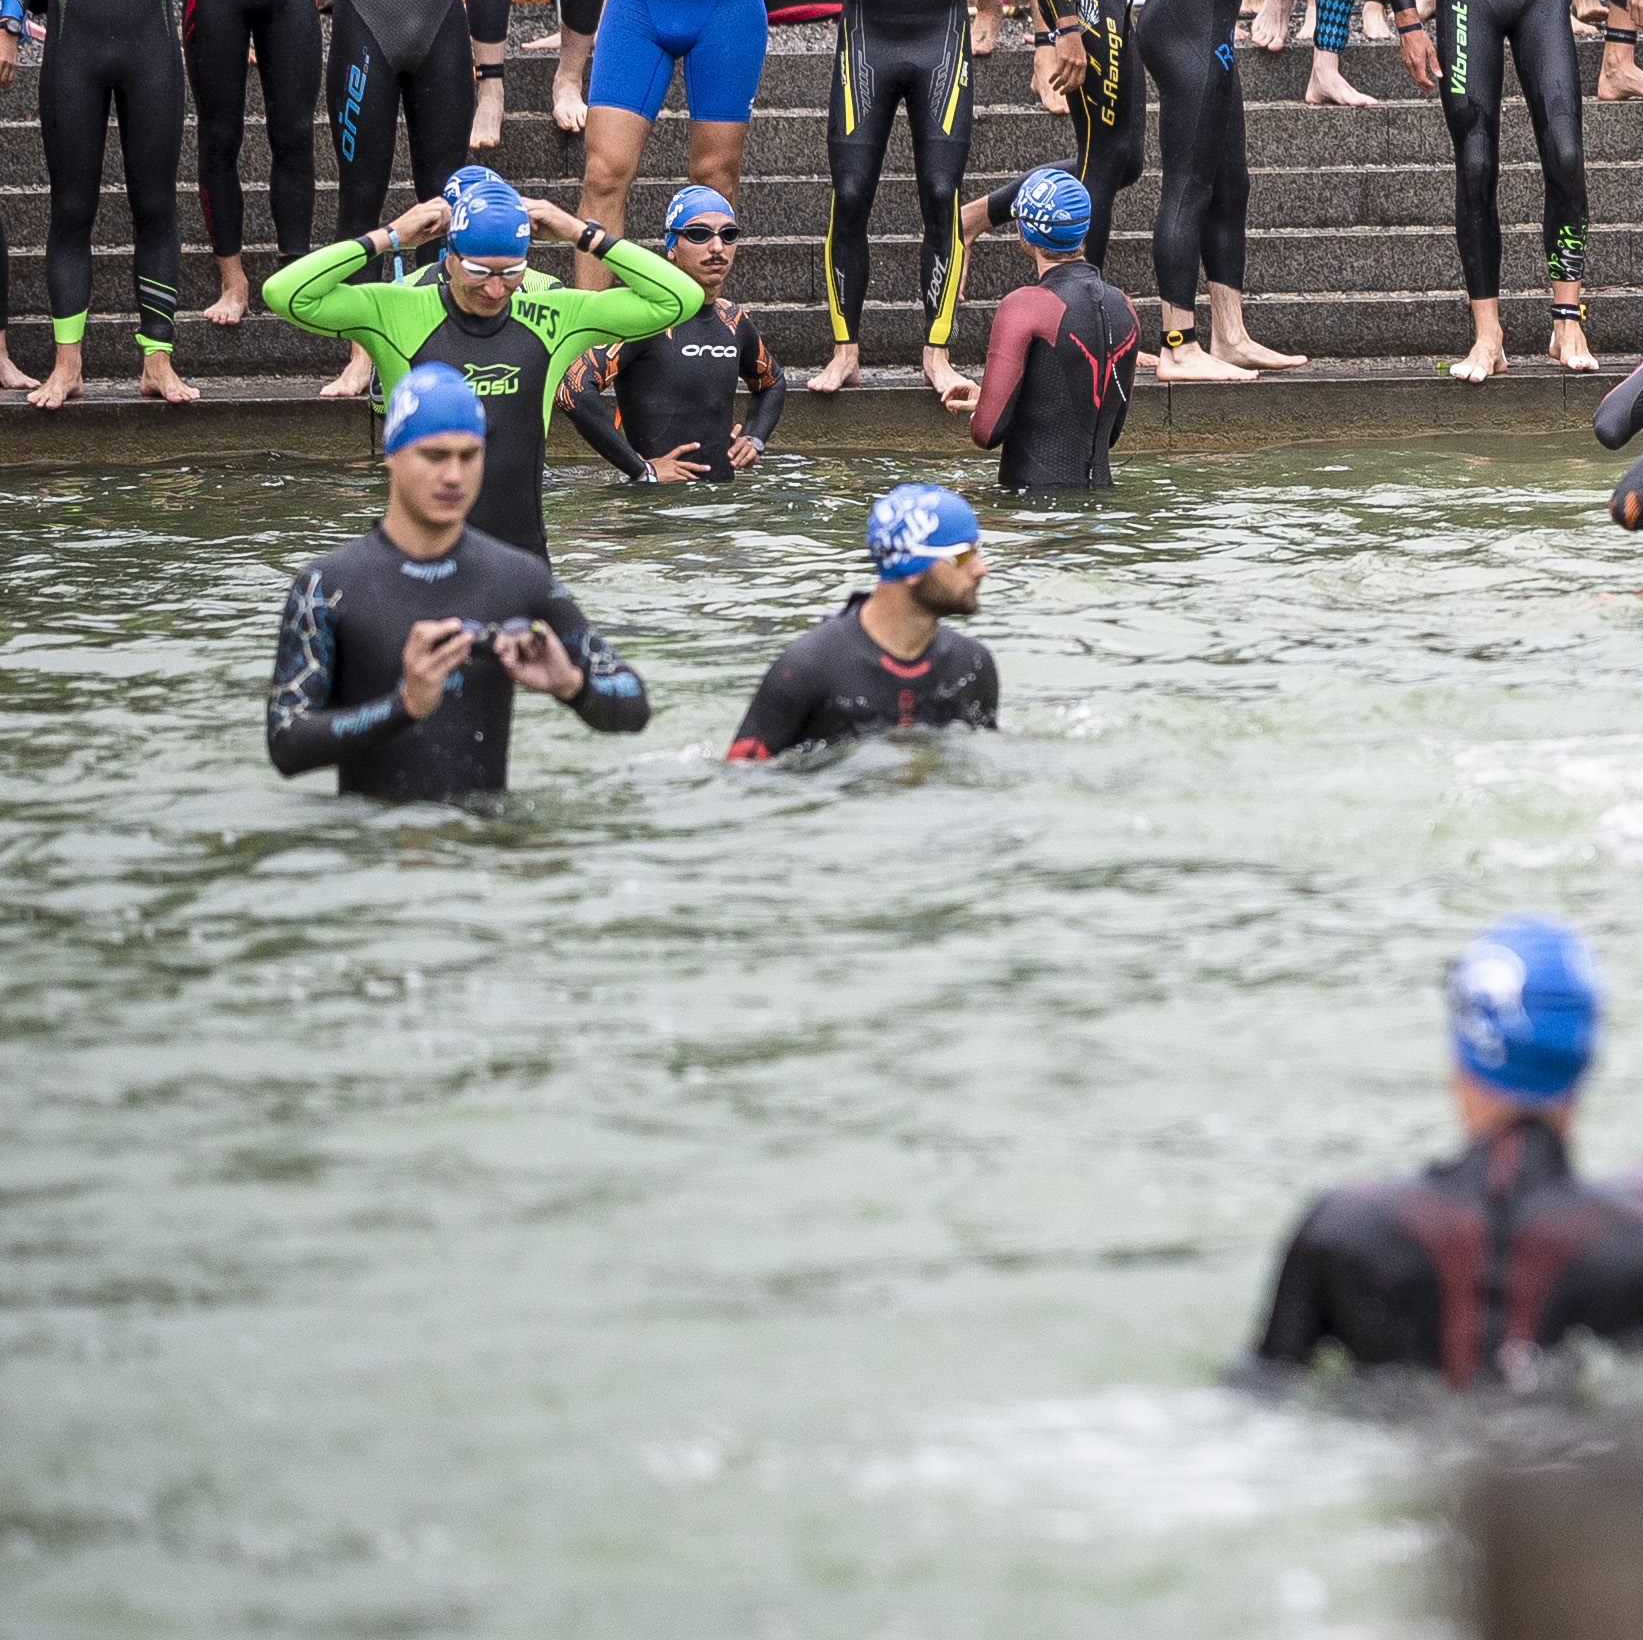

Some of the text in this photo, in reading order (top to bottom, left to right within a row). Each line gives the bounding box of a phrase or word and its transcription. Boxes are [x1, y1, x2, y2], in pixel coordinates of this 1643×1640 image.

[1102, 16, 1123, 127] G-Range
[1449, 0, 1467, 96] Vibrant
[516, 301, 559, 339] MFS
[681, 344, 738, 358] orca
